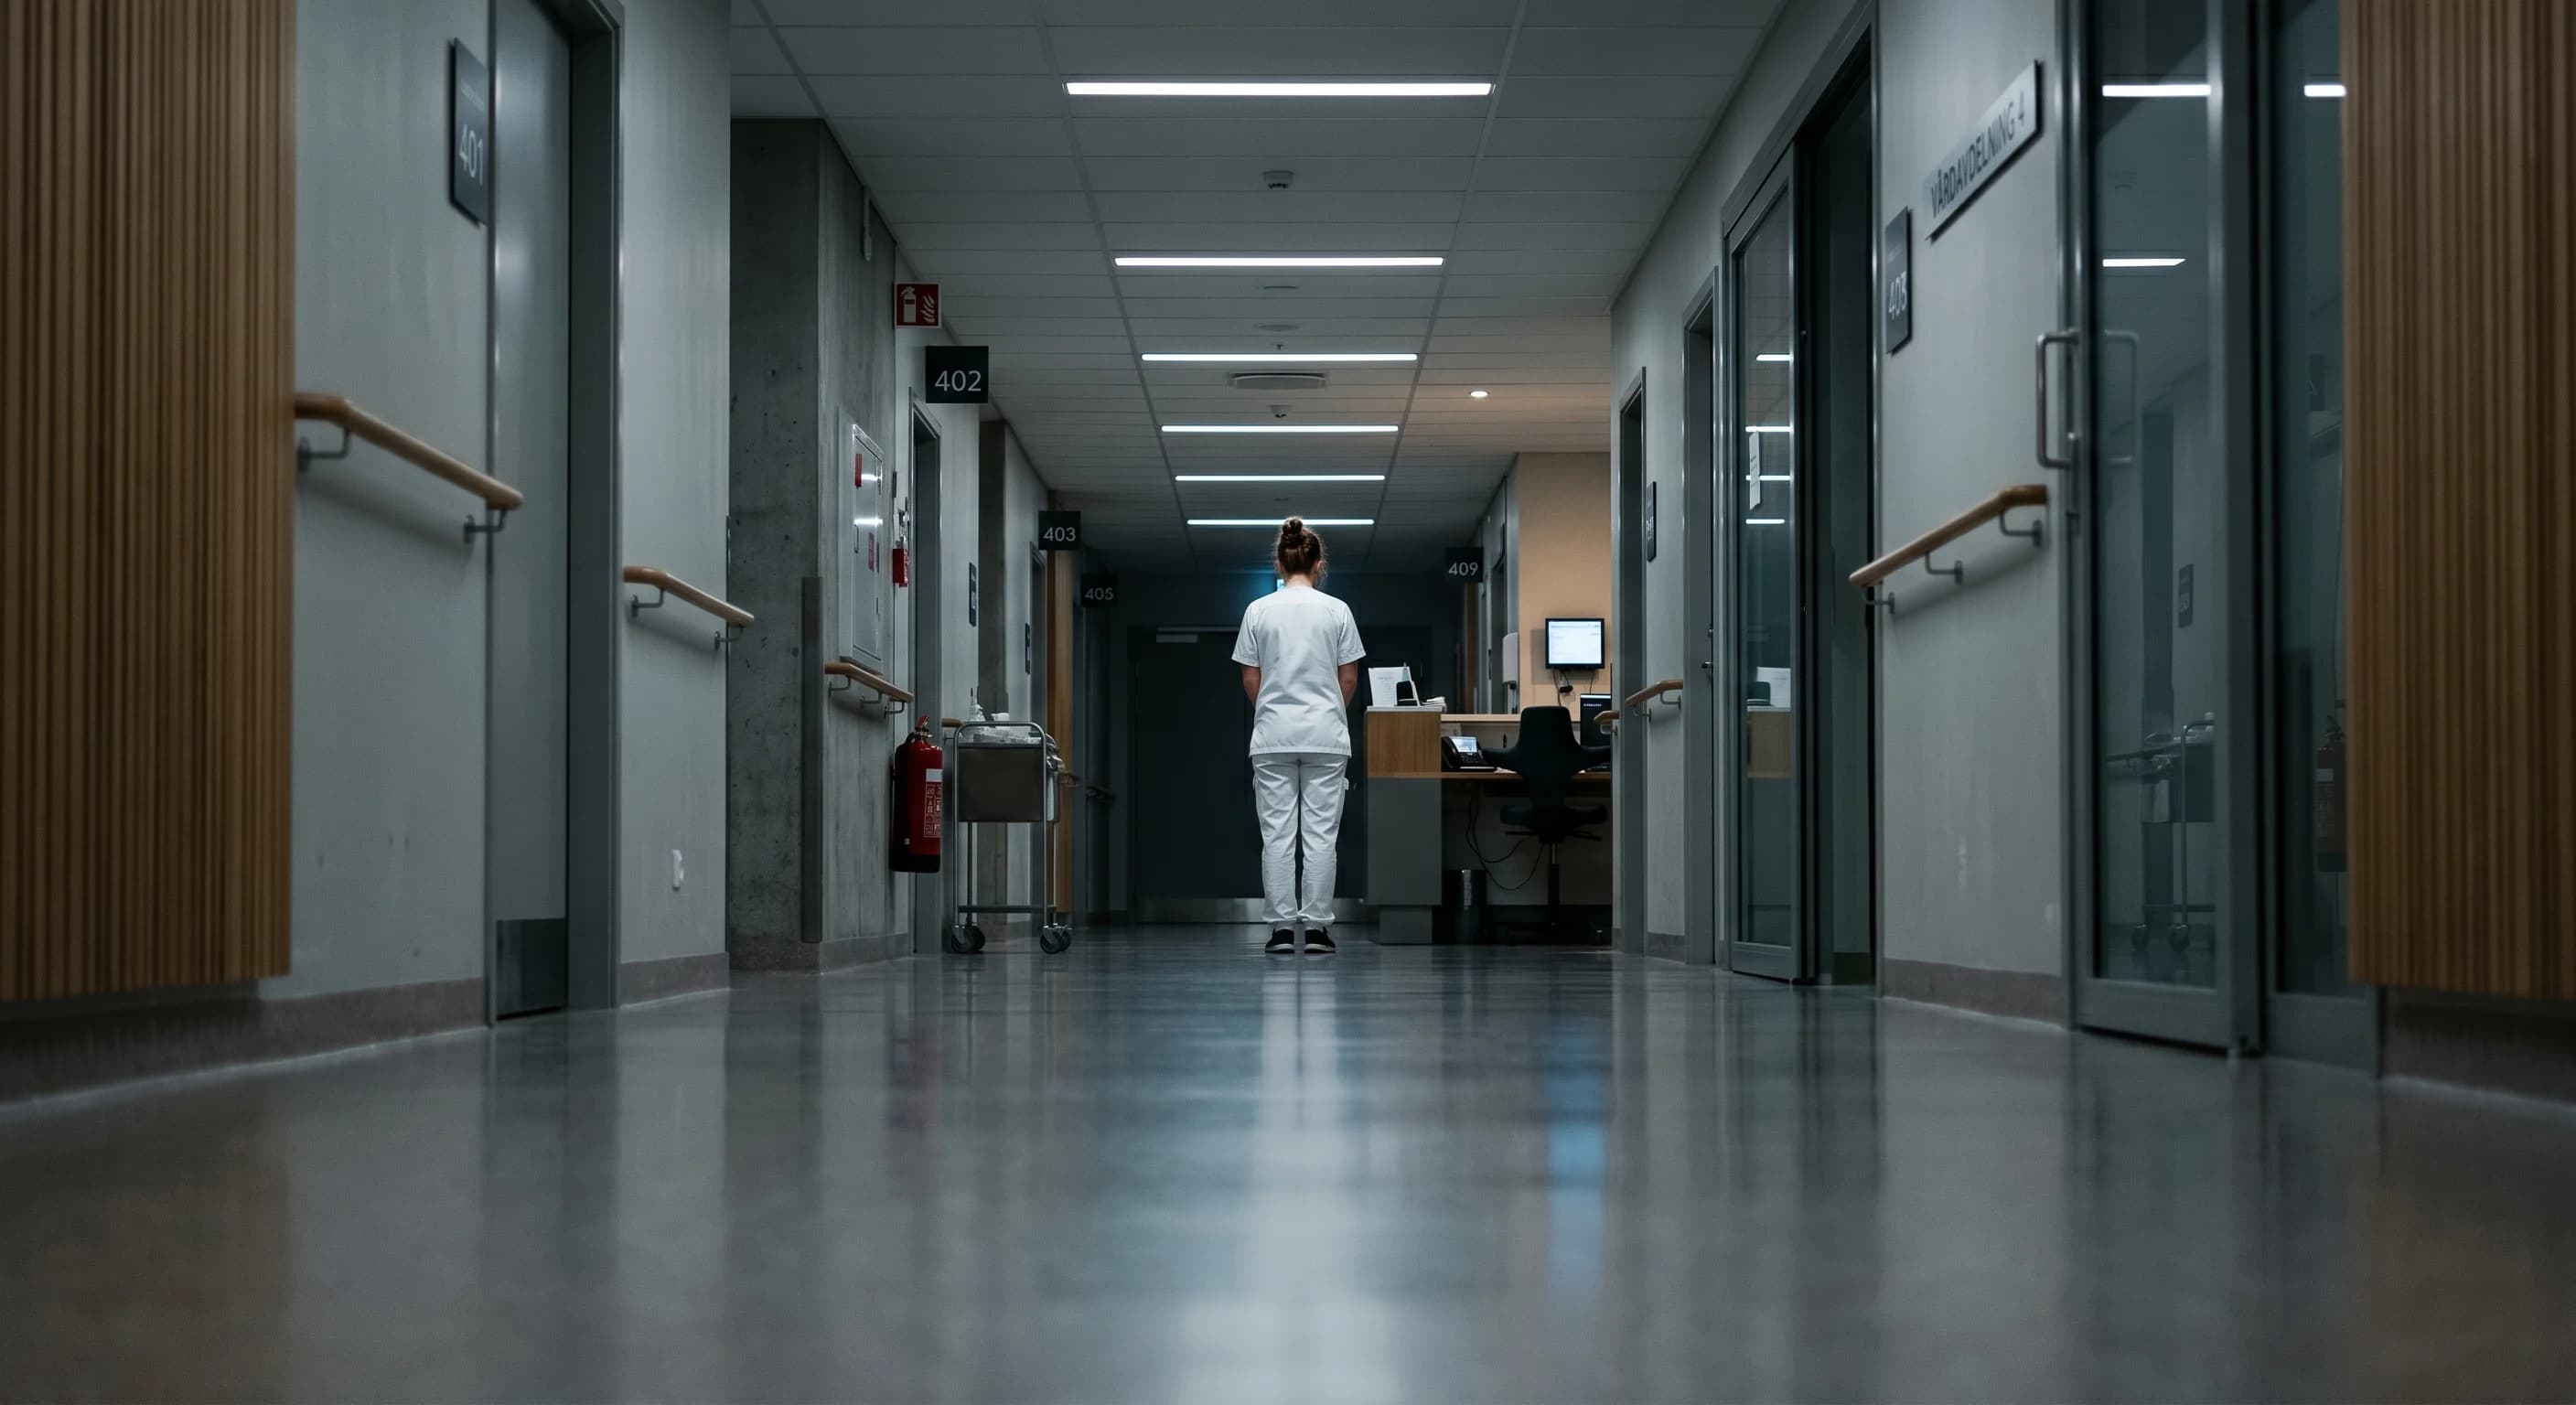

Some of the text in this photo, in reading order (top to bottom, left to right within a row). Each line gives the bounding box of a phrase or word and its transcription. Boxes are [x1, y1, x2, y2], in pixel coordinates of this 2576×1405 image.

[458, 123, 483, 186] 401
[1930, 90, 2025, 218] VÅRDAVDELNING 4
[935, 370, 982, 391] 402
[1043, 527, 1076, 542] 403
[1448, 561, 1478, 575] 409
[1085, 587, 1113, 600] 405
